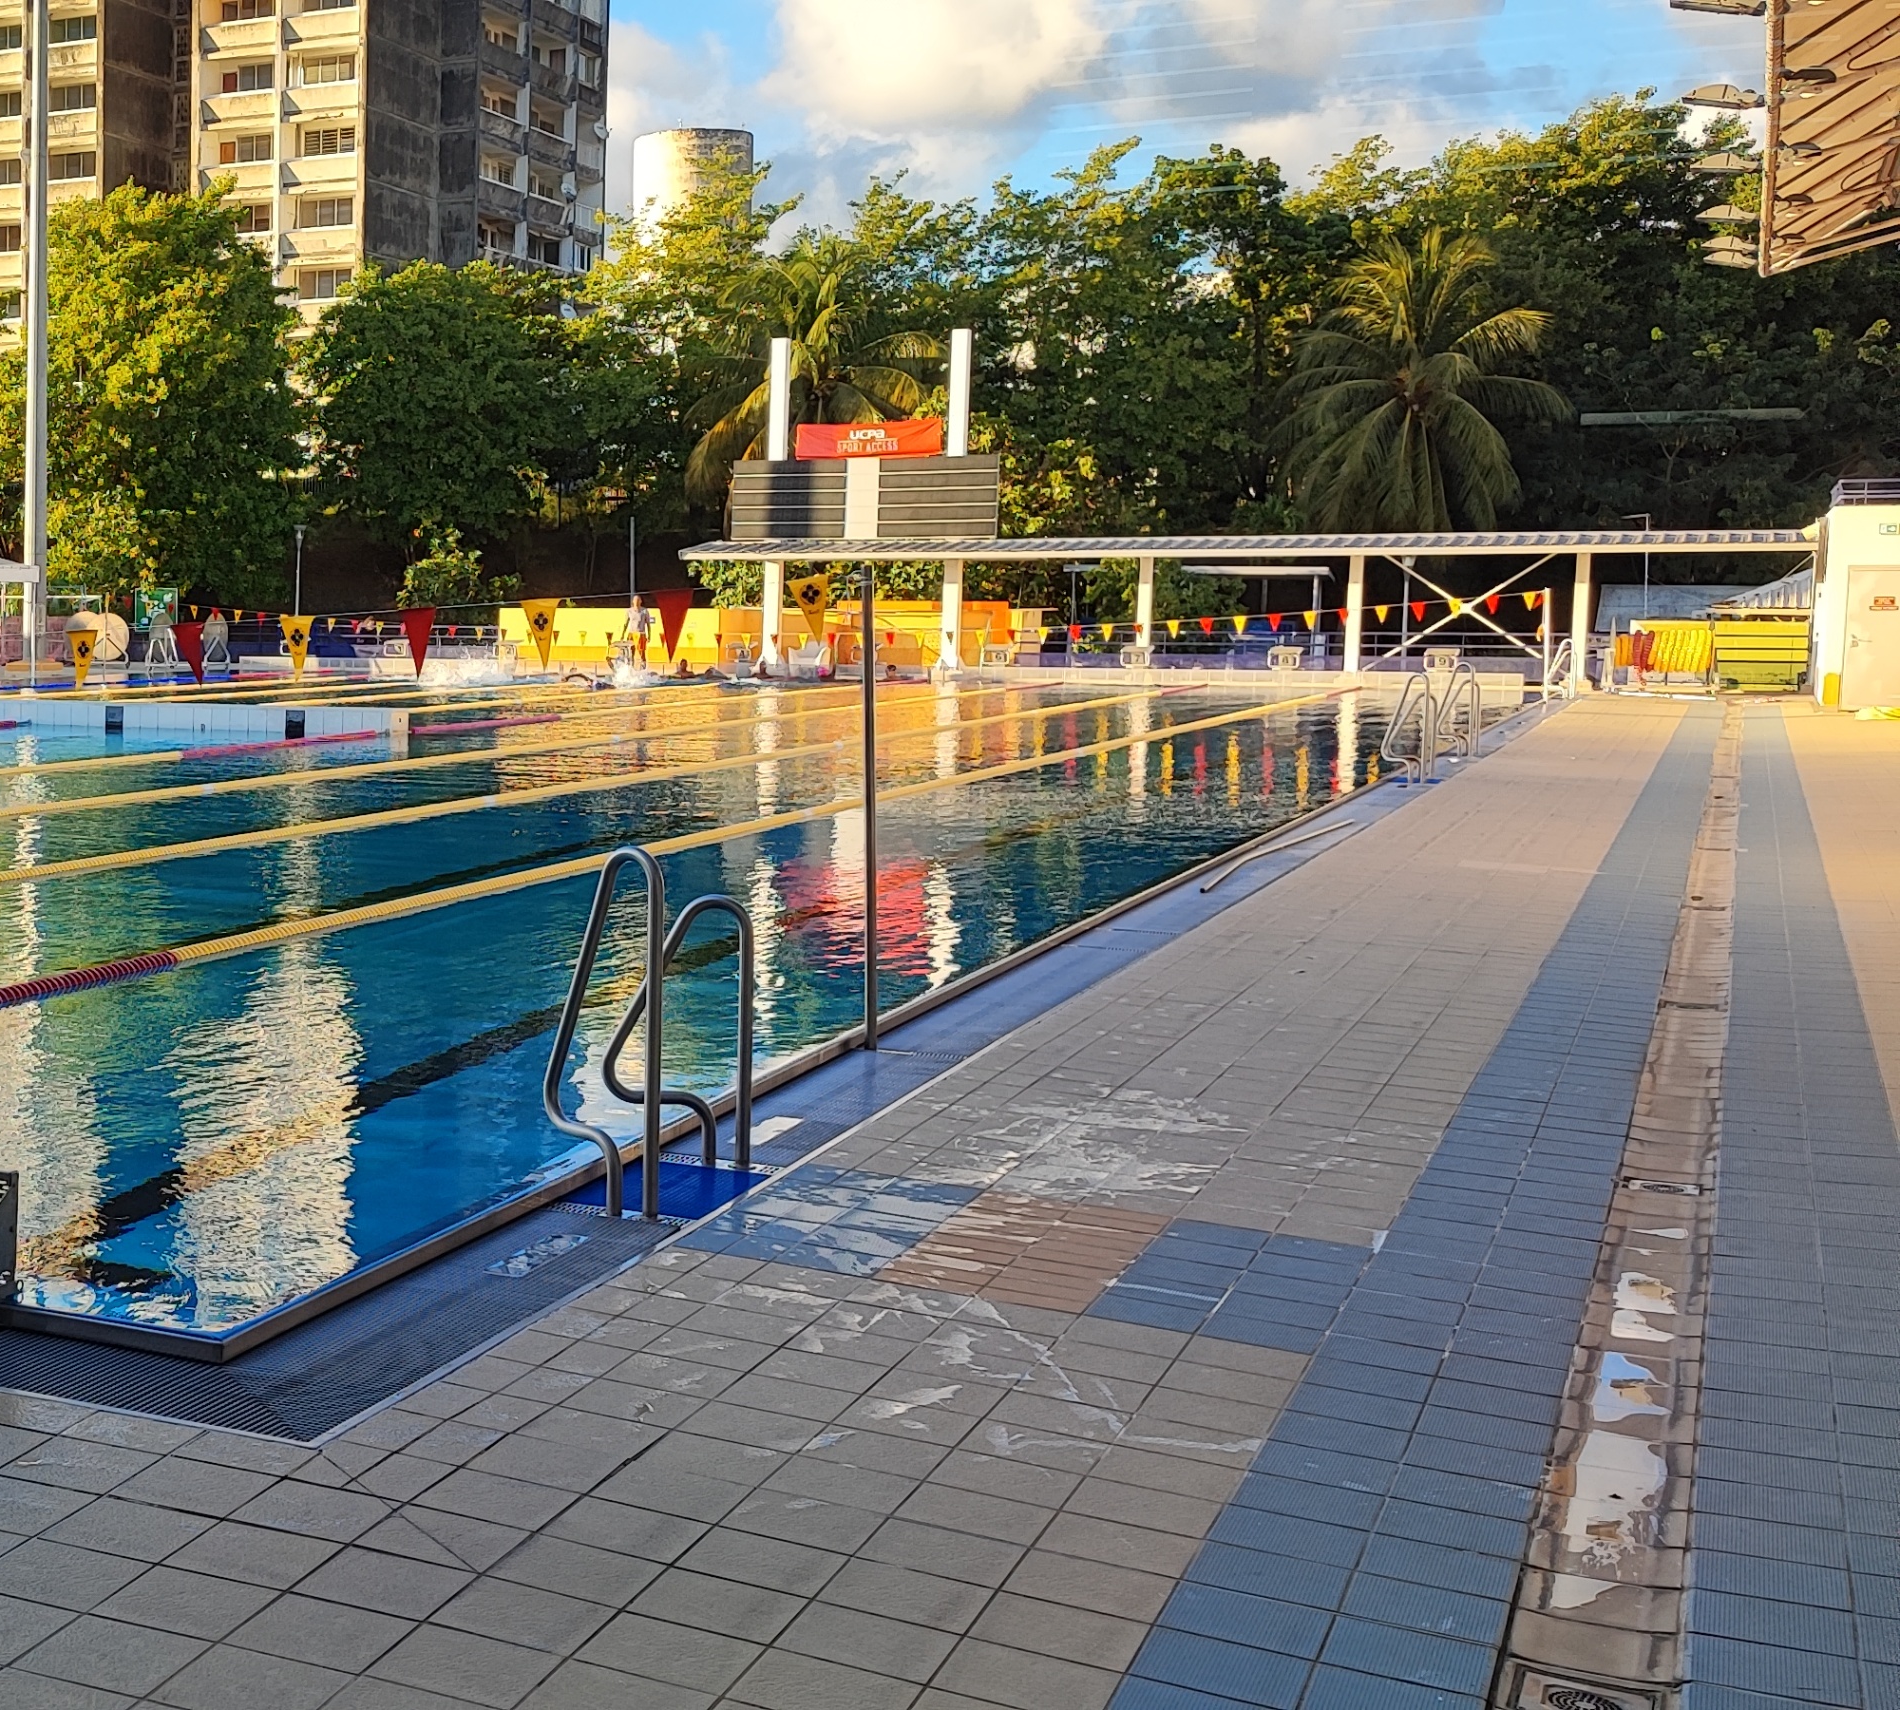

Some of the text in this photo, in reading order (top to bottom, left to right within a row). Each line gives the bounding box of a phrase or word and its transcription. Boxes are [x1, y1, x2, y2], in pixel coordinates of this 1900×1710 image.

[837, 439, 898, 453] SPORT ACCESS
[1134, 654, 1141, 662] 7
[1439, 656, 1446, 666] 9
